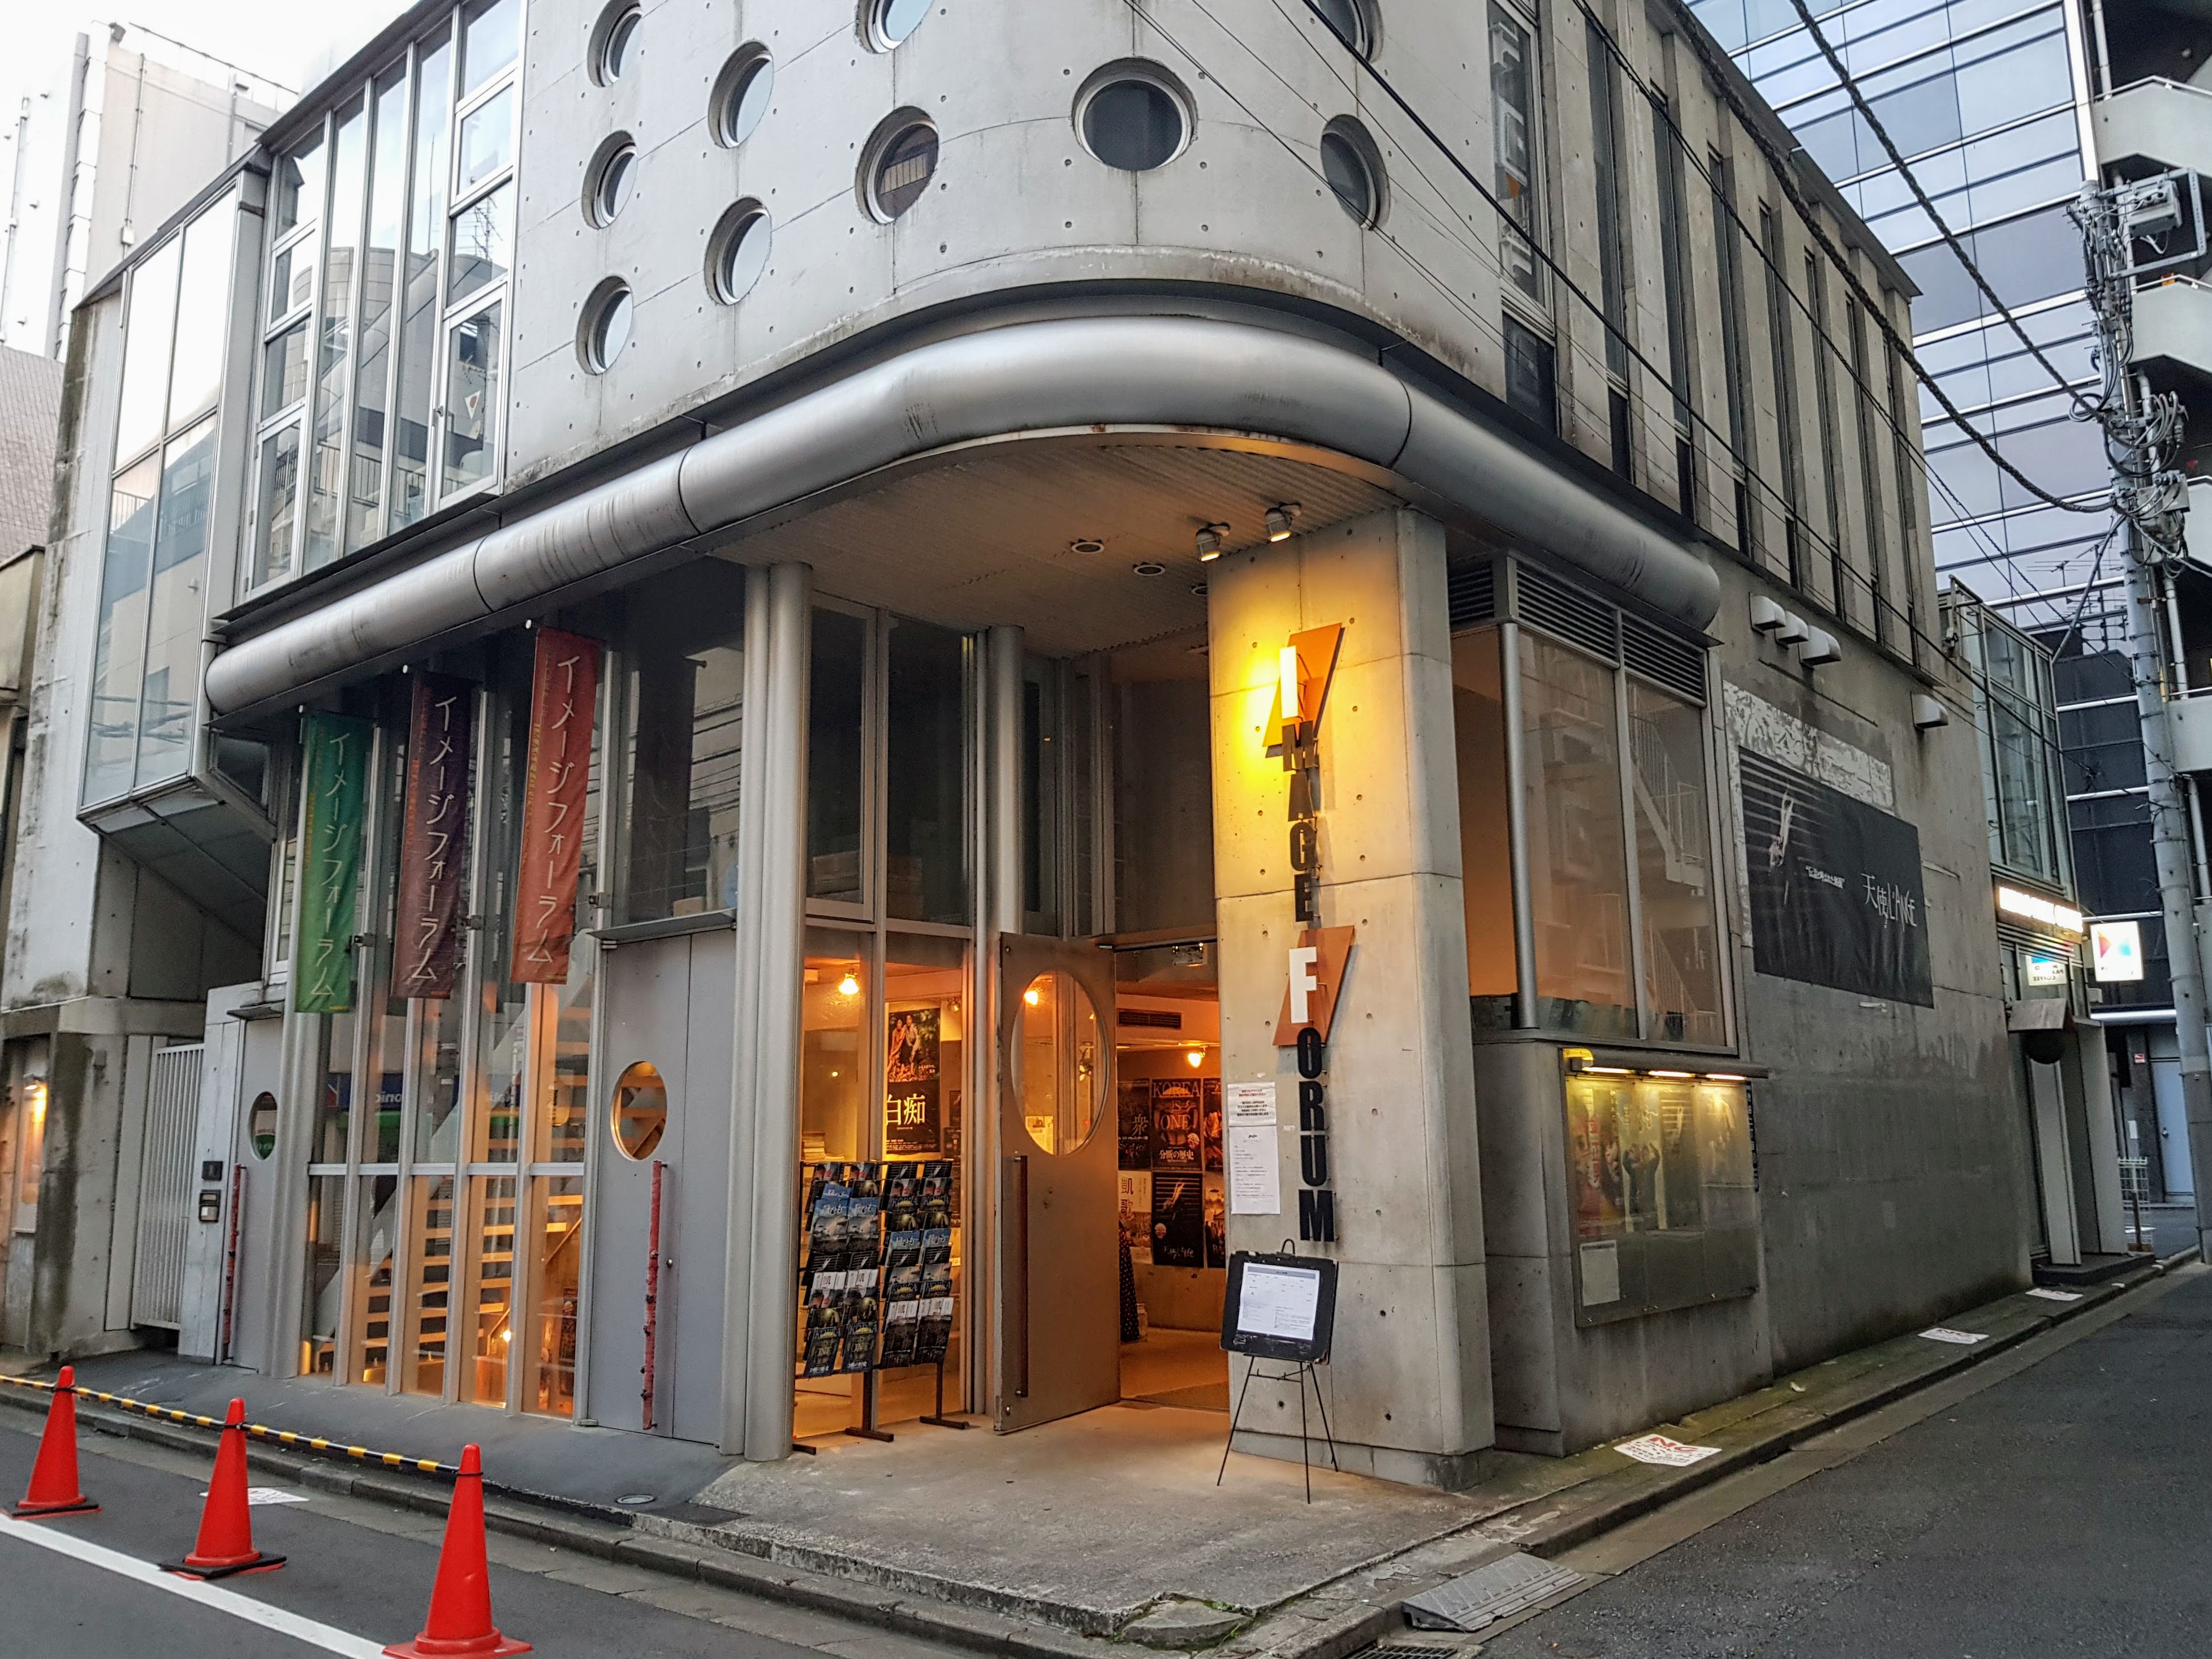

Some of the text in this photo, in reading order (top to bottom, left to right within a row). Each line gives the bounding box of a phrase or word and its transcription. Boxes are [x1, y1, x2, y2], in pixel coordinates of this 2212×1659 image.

[310, 732, 351, 997] イメージフォーラム
[411, 696, 457, 981] イメージフォーラム
[527, 656, 580, 964] イメージフォーラム
[1279, 645, 1317, 923] IMAGE
[886, 1093, 926, 1126] 白痴
[1153, 1081, 1201, 1097] KOREA
[1160, 1114, 1191, 1131] ONE
[1288, 946, 1335, 1243] FORUM
